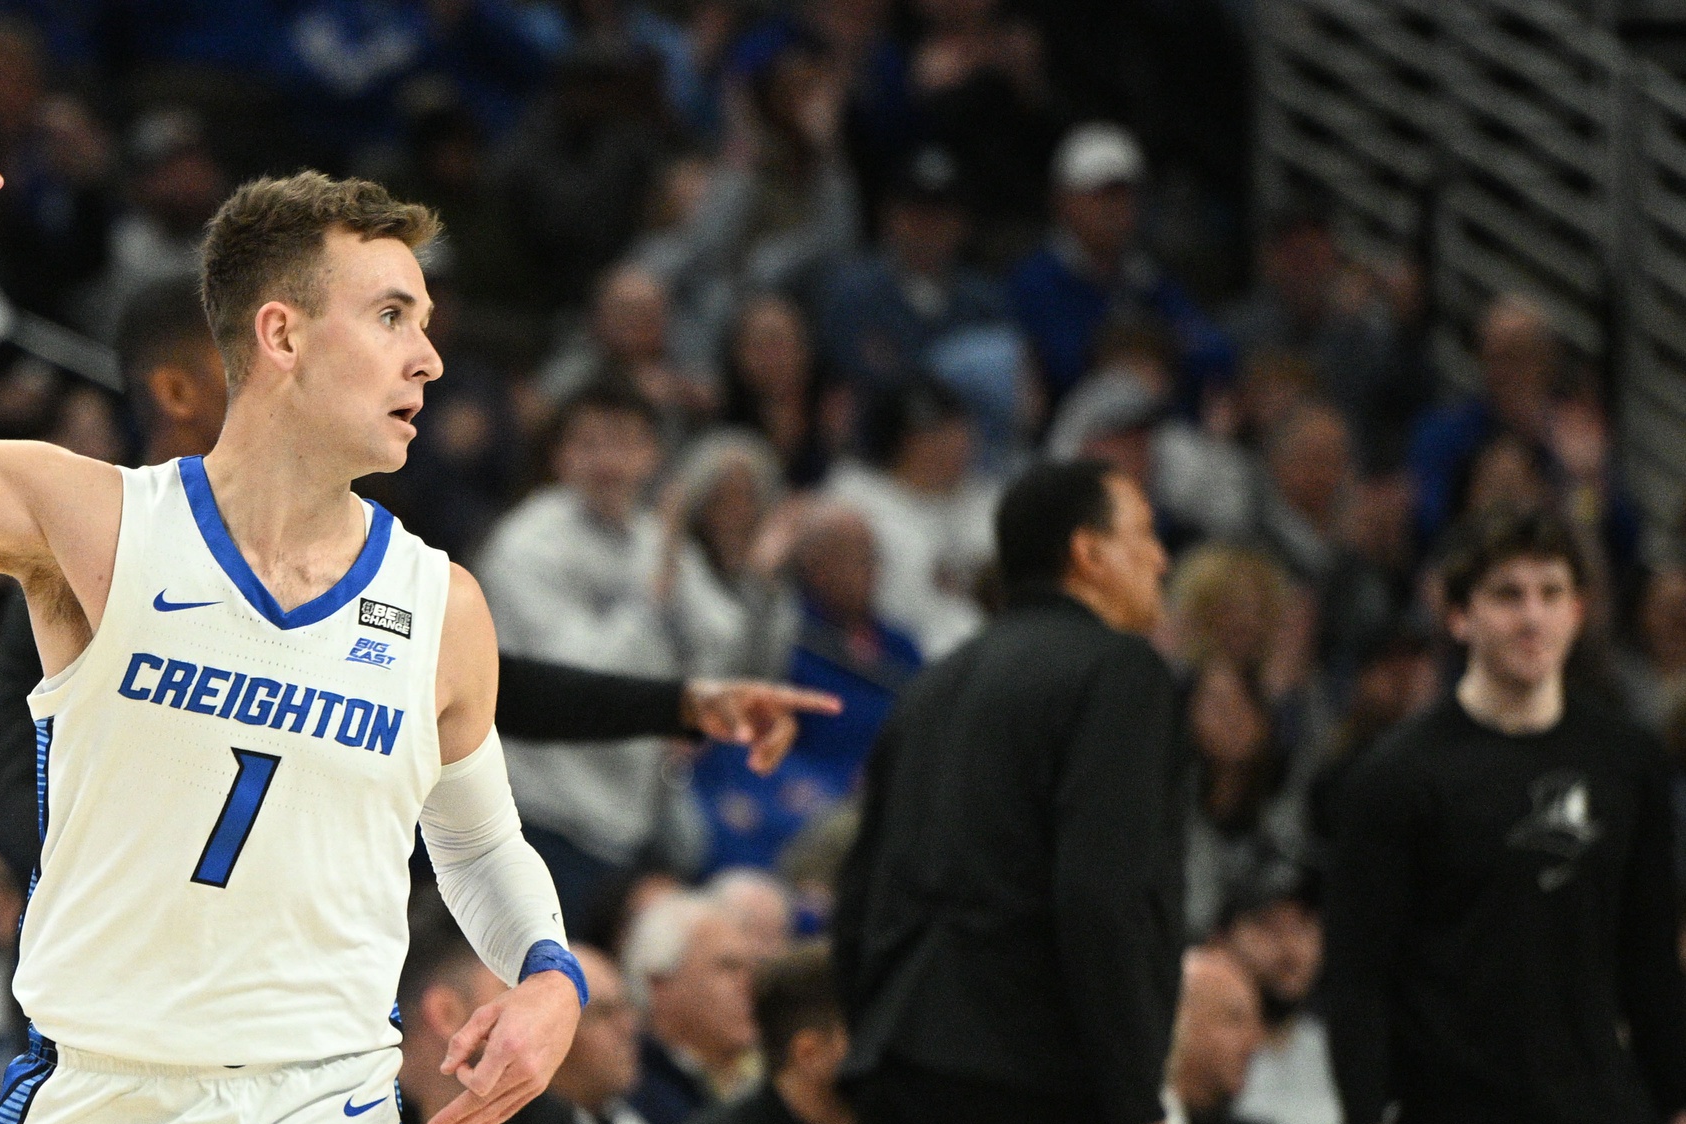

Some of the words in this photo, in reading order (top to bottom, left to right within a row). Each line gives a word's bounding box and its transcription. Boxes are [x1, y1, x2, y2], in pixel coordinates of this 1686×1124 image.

[360, 613, 411, 635] CHANGE
[349, 647, 397, 665] EAST
[355, 637, 391, 653] BIG
[117, 652, 405, 756] CREIGHTON
[190, 746, 282, 889] 1
